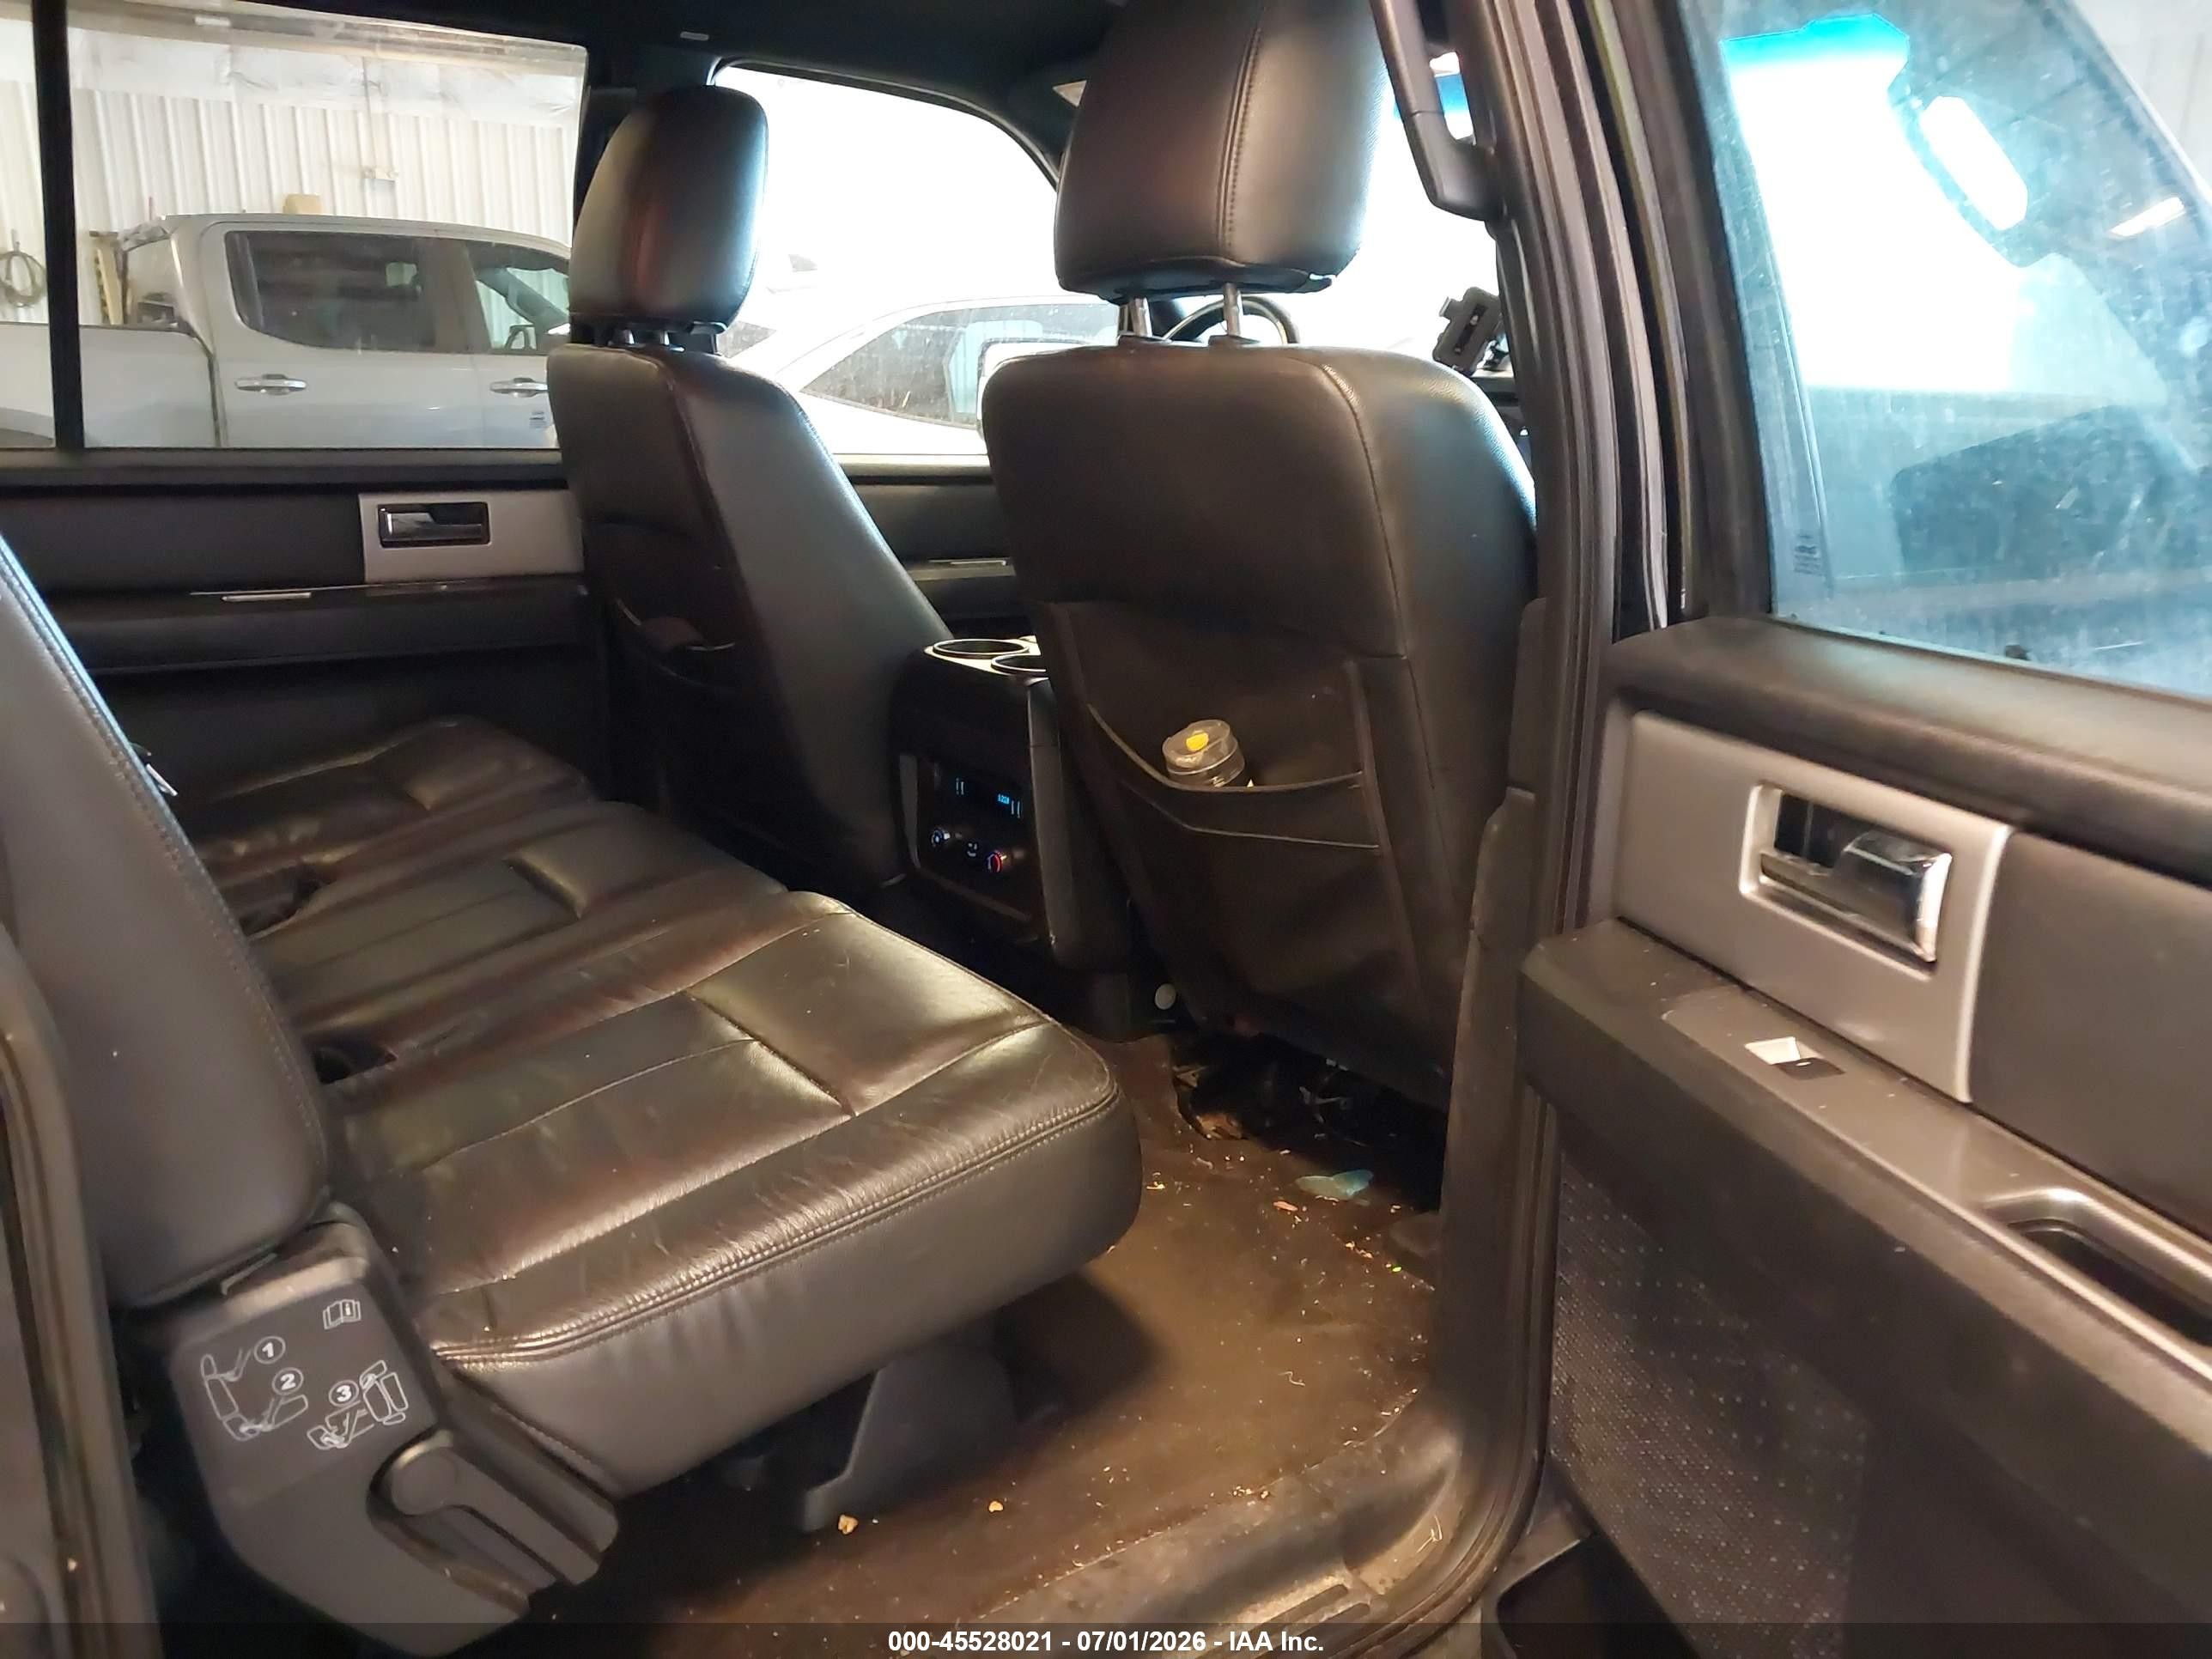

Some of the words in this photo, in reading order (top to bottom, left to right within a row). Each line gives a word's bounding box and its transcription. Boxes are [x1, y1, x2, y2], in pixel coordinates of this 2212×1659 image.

[262, 1342, 274, 1358] 1
[280, 1373, 296, 1390] 2
[337, 1385, 351, 1401] 3
